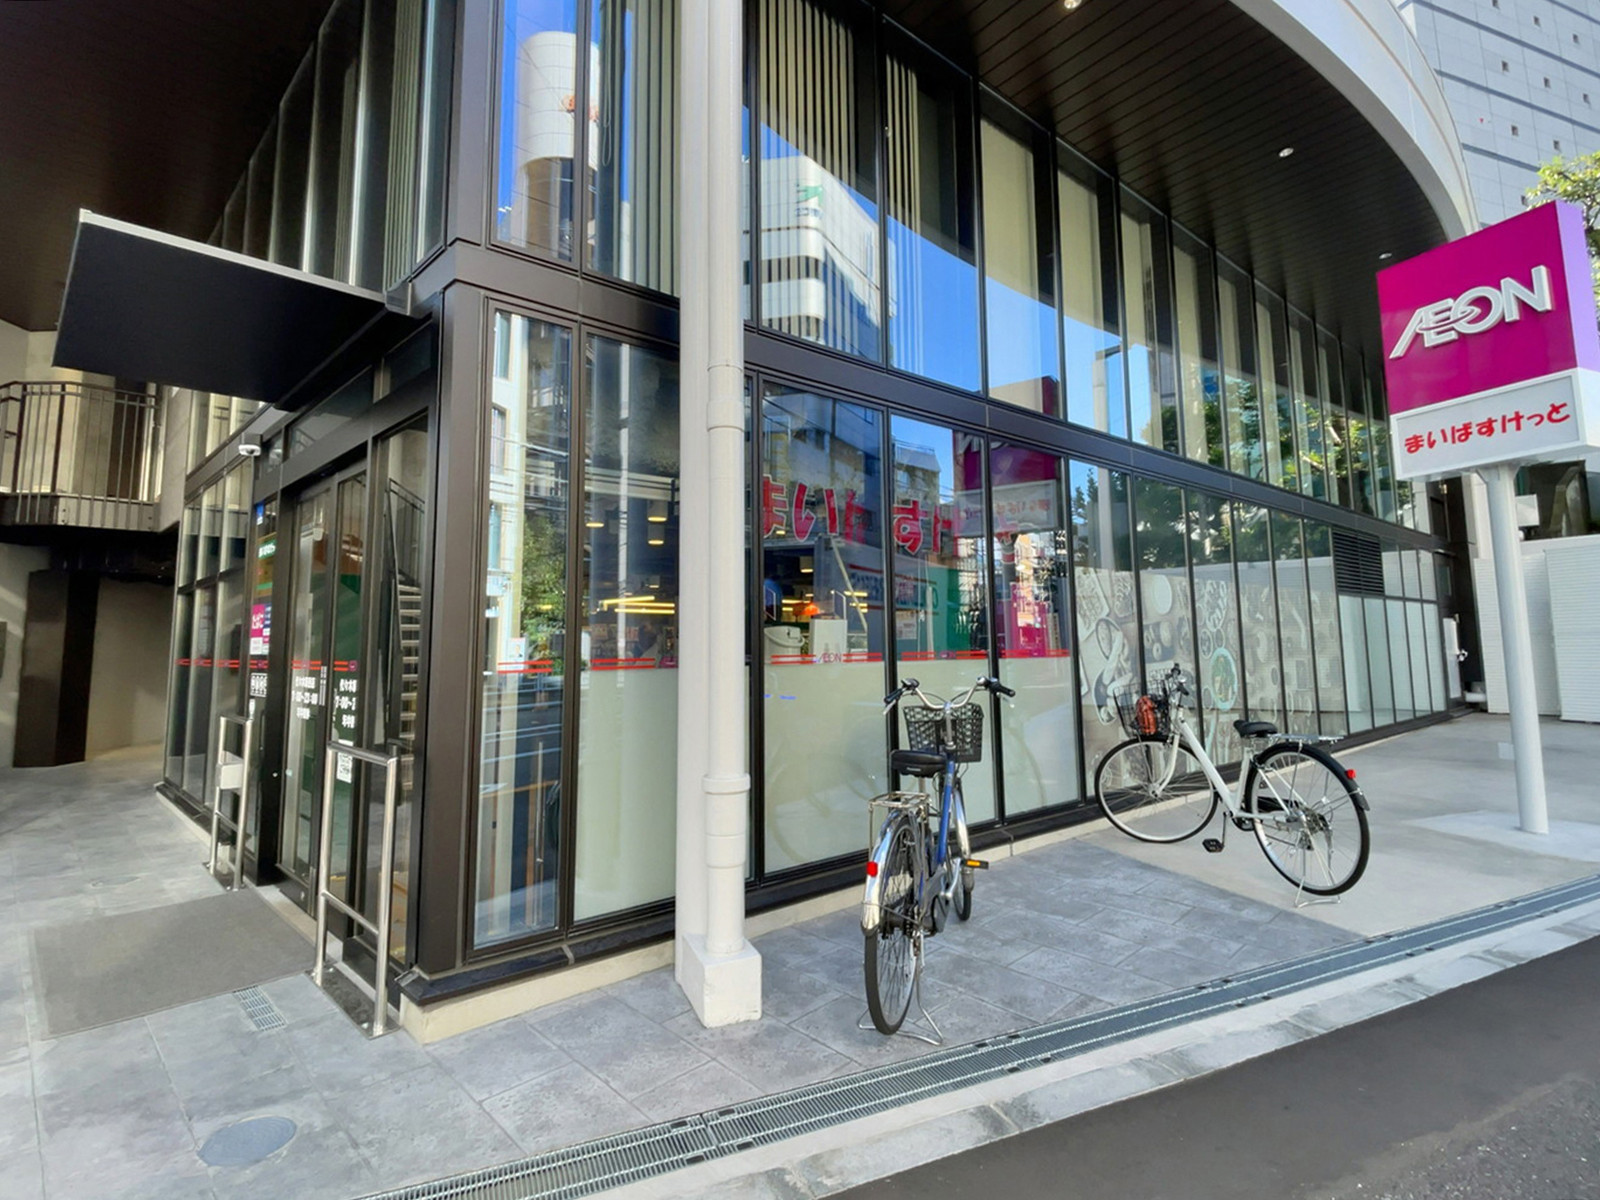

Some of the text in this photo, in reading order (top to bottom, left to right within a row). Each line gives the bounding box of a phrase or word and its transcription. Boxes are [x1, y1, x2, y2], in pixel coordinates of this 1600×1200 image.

[1404, 402, 1571, 454] まいばすけっと
